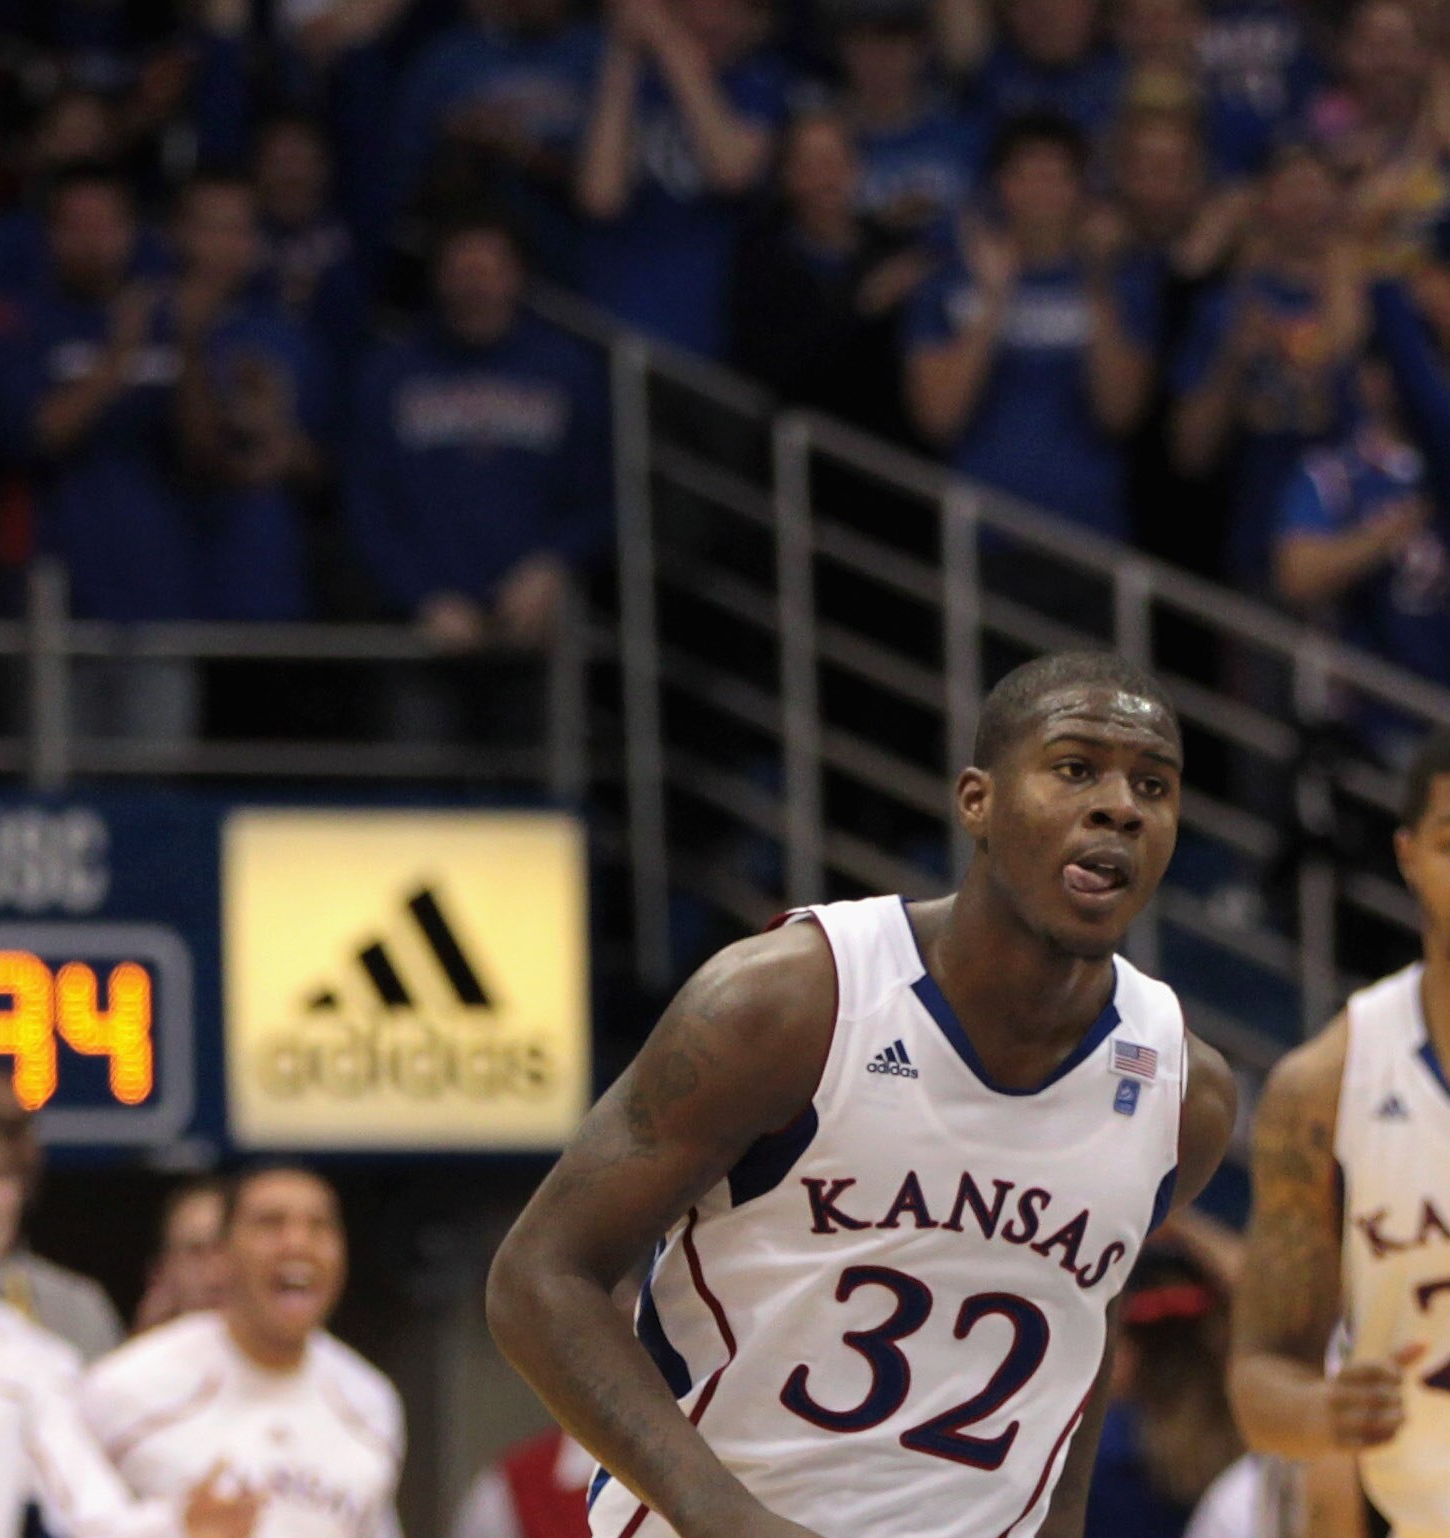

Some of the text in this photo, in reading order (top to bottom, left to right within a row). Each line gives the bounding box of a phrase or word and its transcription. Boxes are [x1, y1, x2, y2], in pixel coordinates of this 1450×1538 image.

[255, 1020, 559, 1103] adidas
[866, 1059, 919, 1080] adidas
[800, 1169, 1127, 1290] KANSAS
[779, 1264, 1051, 1472] 32
